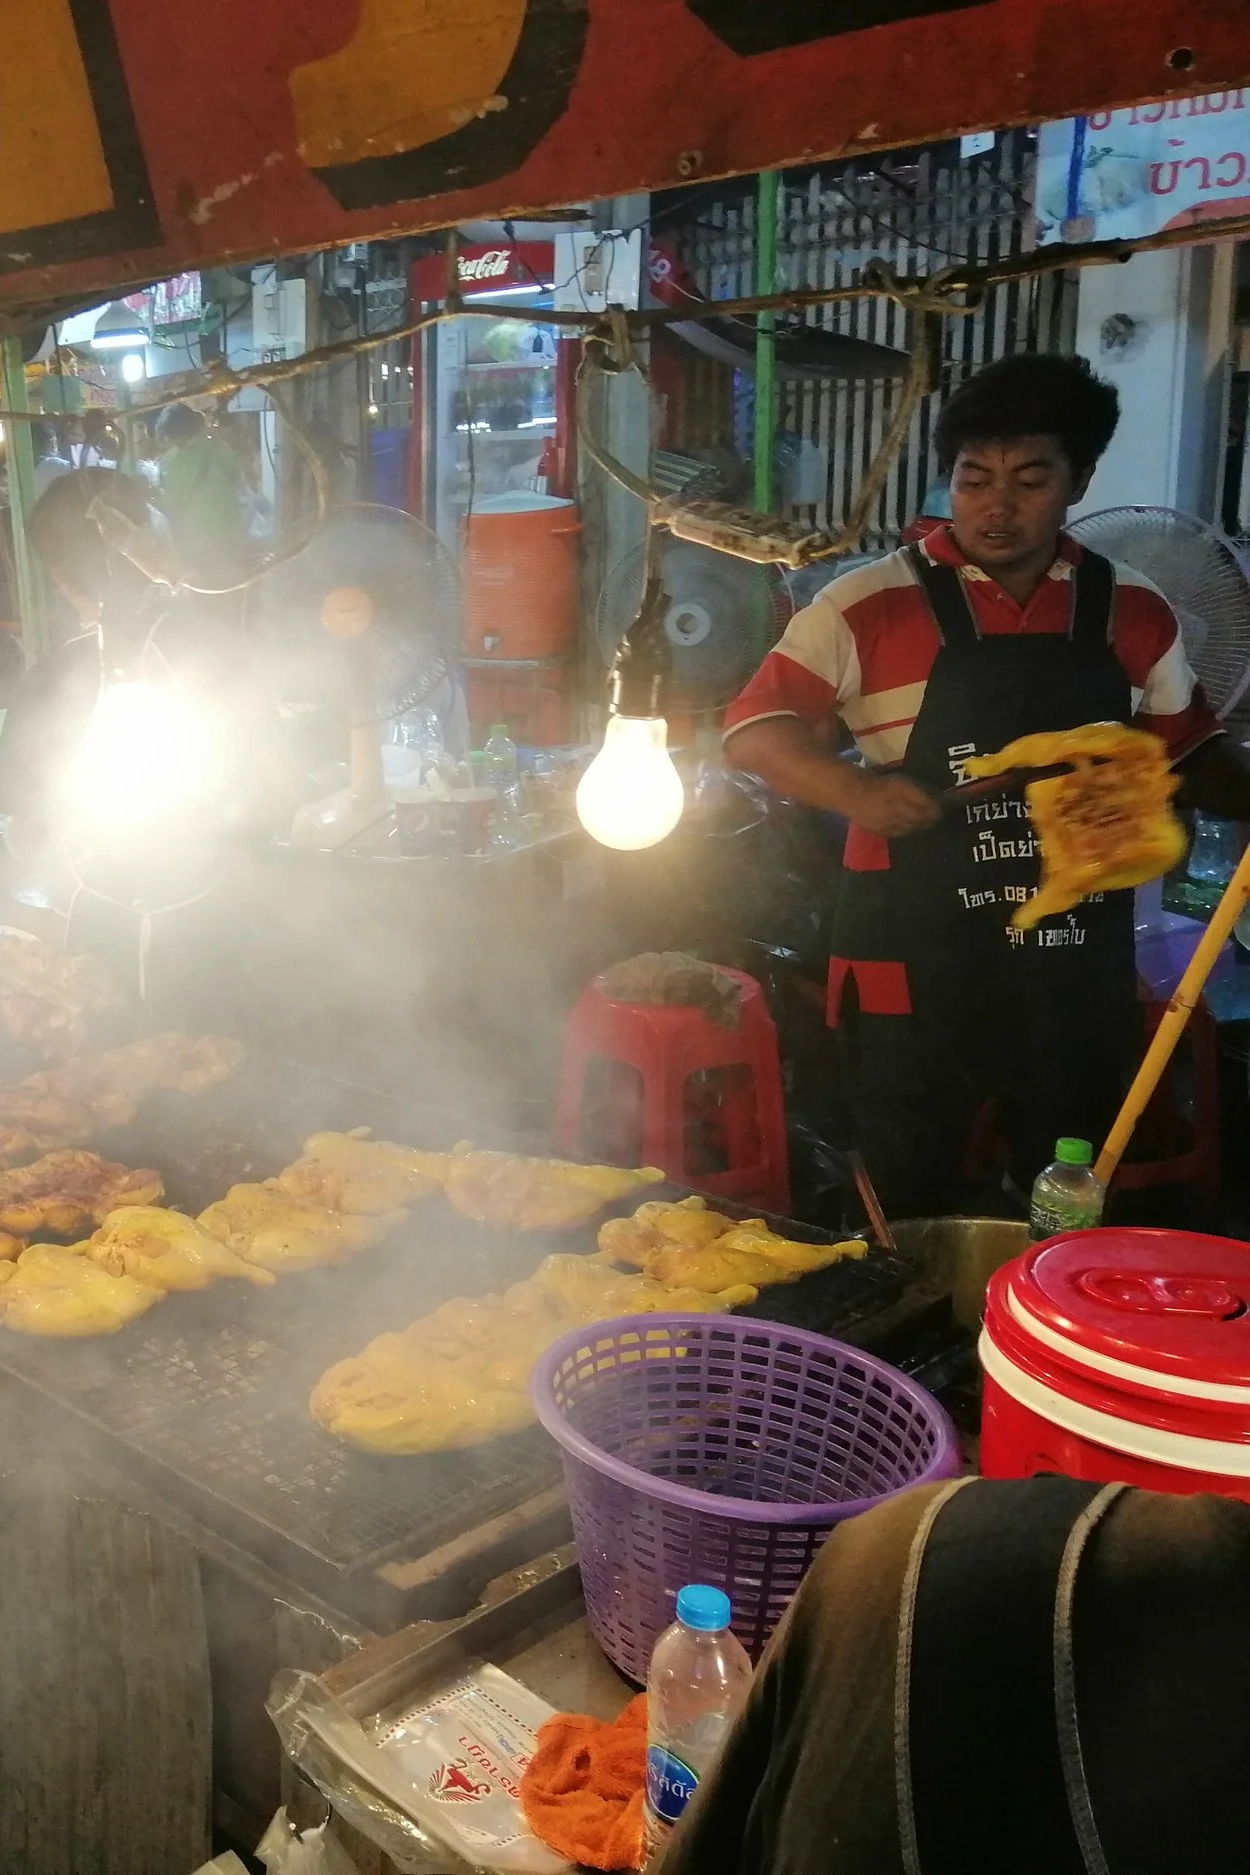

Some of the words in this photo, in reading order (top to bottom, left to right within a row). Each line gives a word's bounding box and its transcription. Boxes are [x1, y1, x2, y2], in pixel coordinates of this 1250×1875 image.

[1150, 138, 1250, 195] ข้าว
[972, 830, 1042, 862] เป็ดย่
